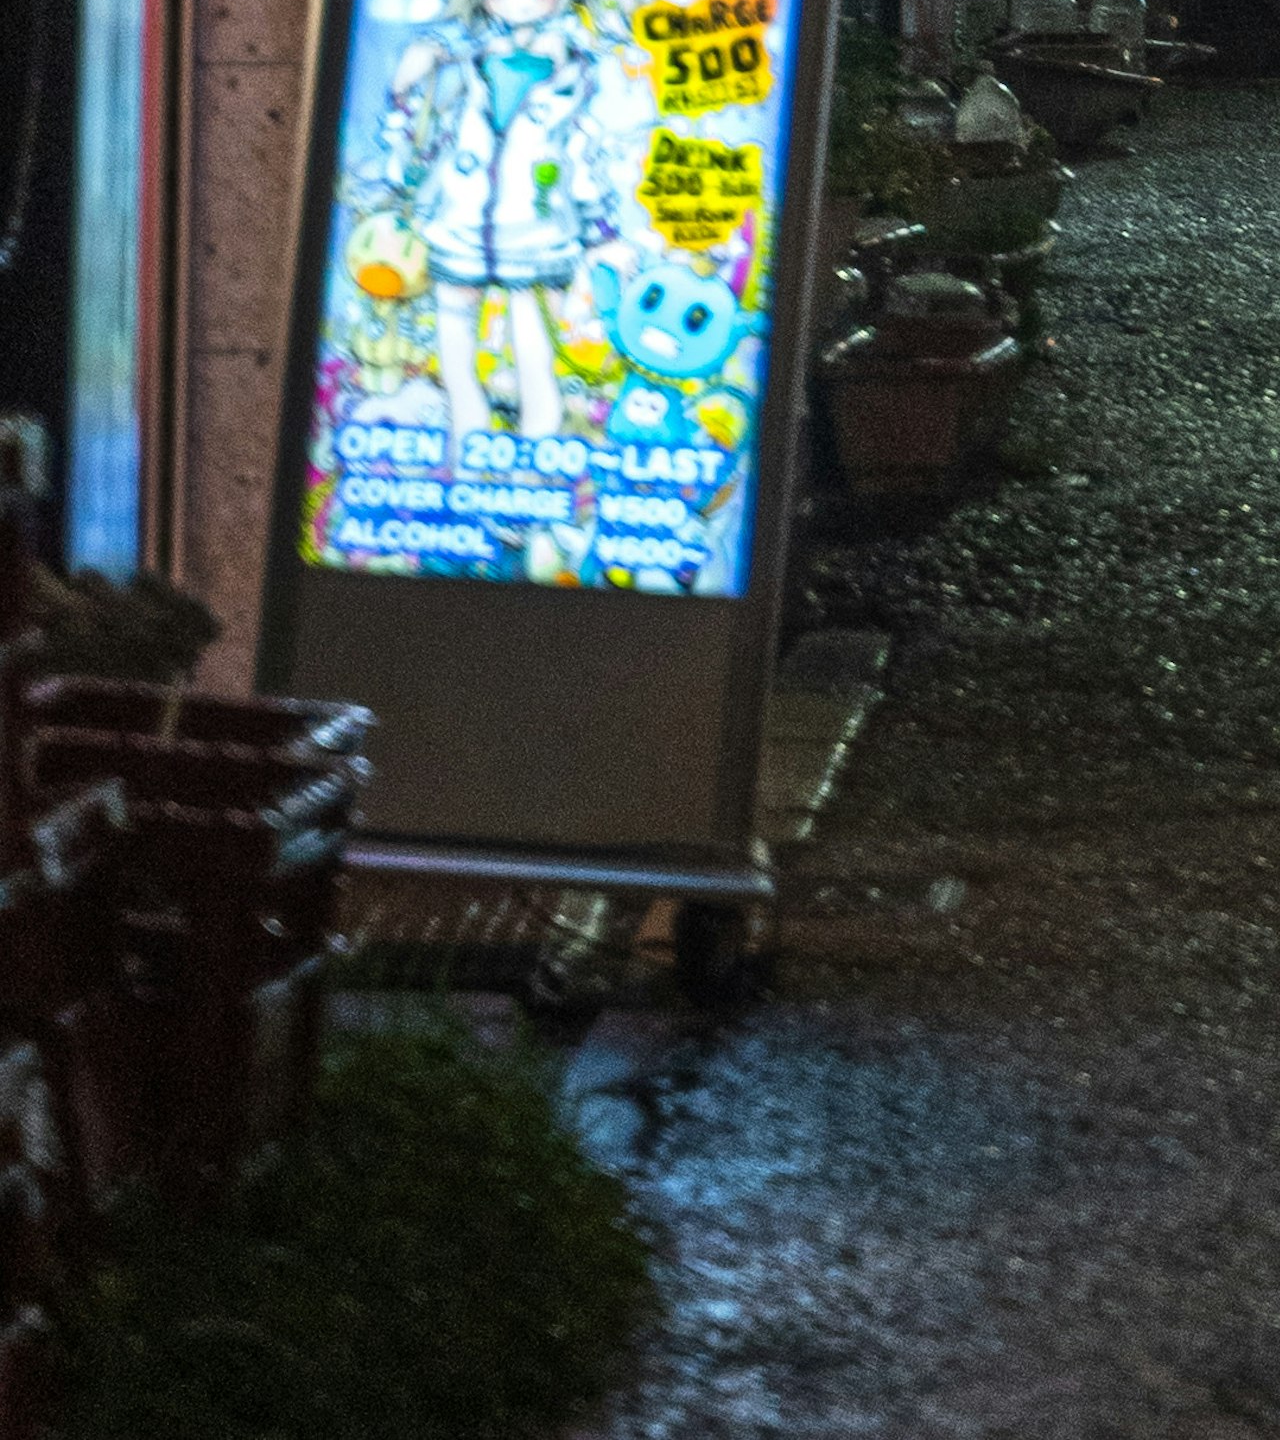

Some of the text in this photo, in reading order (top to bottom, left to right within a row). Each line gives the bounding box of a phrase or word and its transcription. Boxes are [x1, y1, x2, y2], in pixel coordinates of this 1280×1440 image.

[664, 36, 761, 86] 500
[337, 424, 445, 465] OPEN
[342, 477, 445, 511] COVER
[446, 485, 573, 521] CHARGE
[336, 516, 496, 560] ALCOHOL
